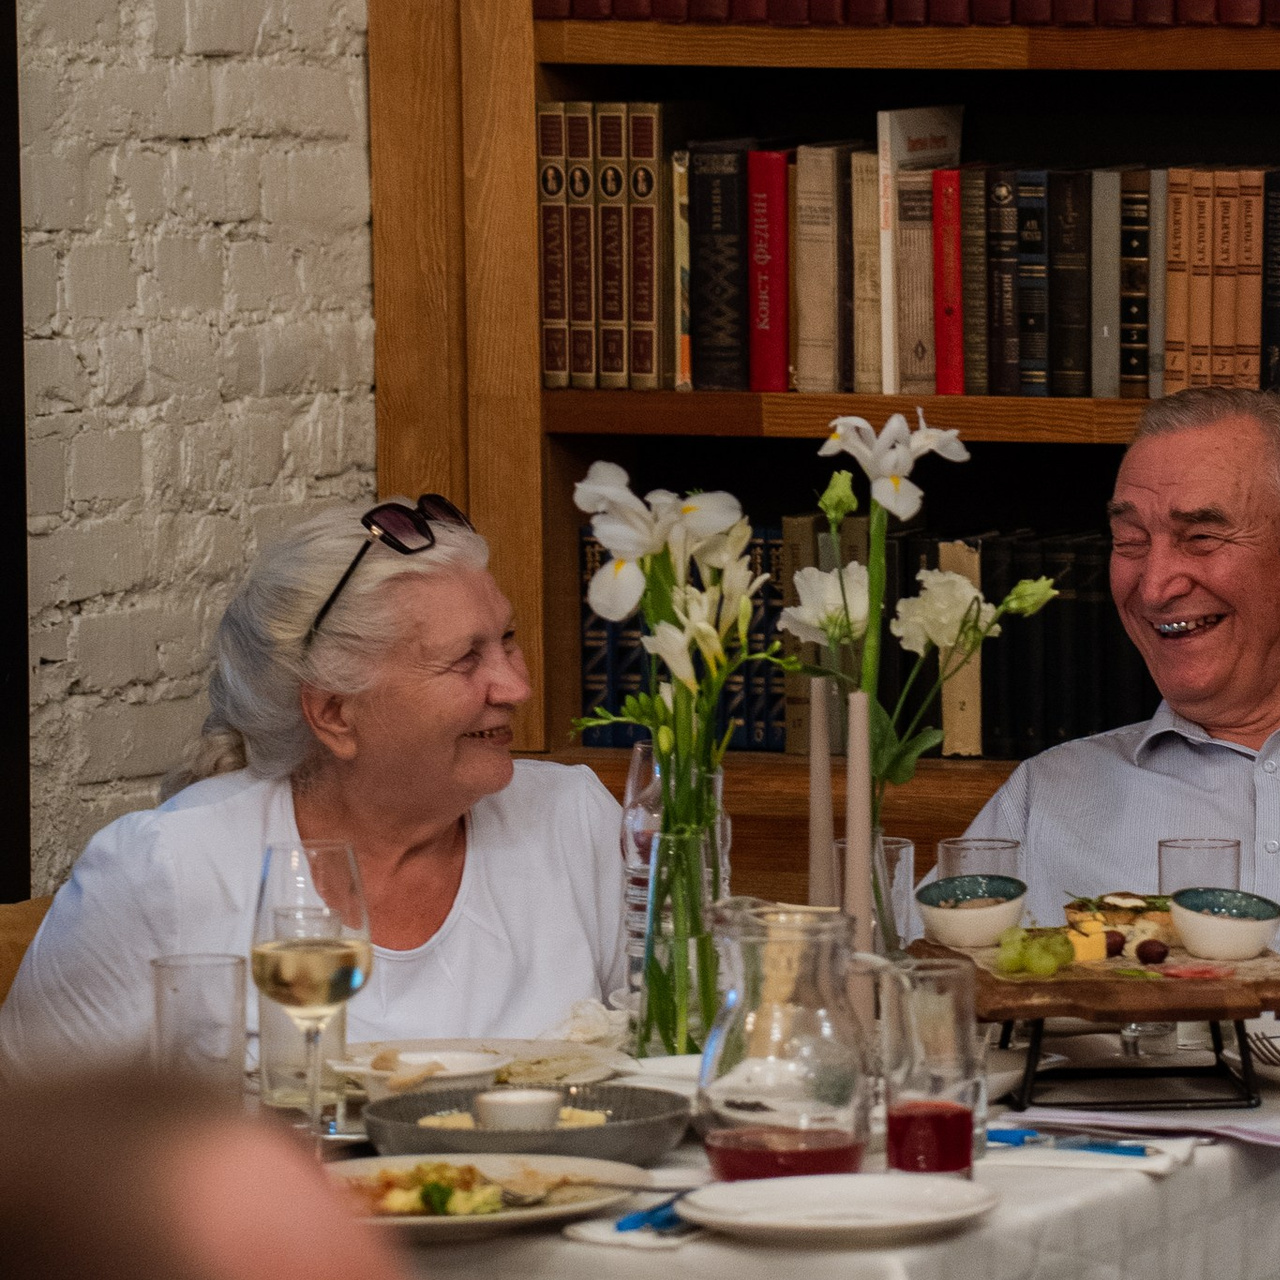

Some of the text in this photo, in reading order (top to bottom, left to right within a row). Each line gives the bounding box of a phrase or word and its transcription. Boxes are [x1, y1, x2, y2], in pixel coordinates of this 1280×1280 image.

[545, 213, 562, 267] ДАЛЬ
[574, 215, 592, 269] ДАЛЬ
[604, 214, 622, 268] ДАЛЬ
[636, 214, 653, 268] ДАЛЬ
[752, 192, 772, 266] ФЕДИН
[1001, 273, 1014, 326] ПУШКИН
